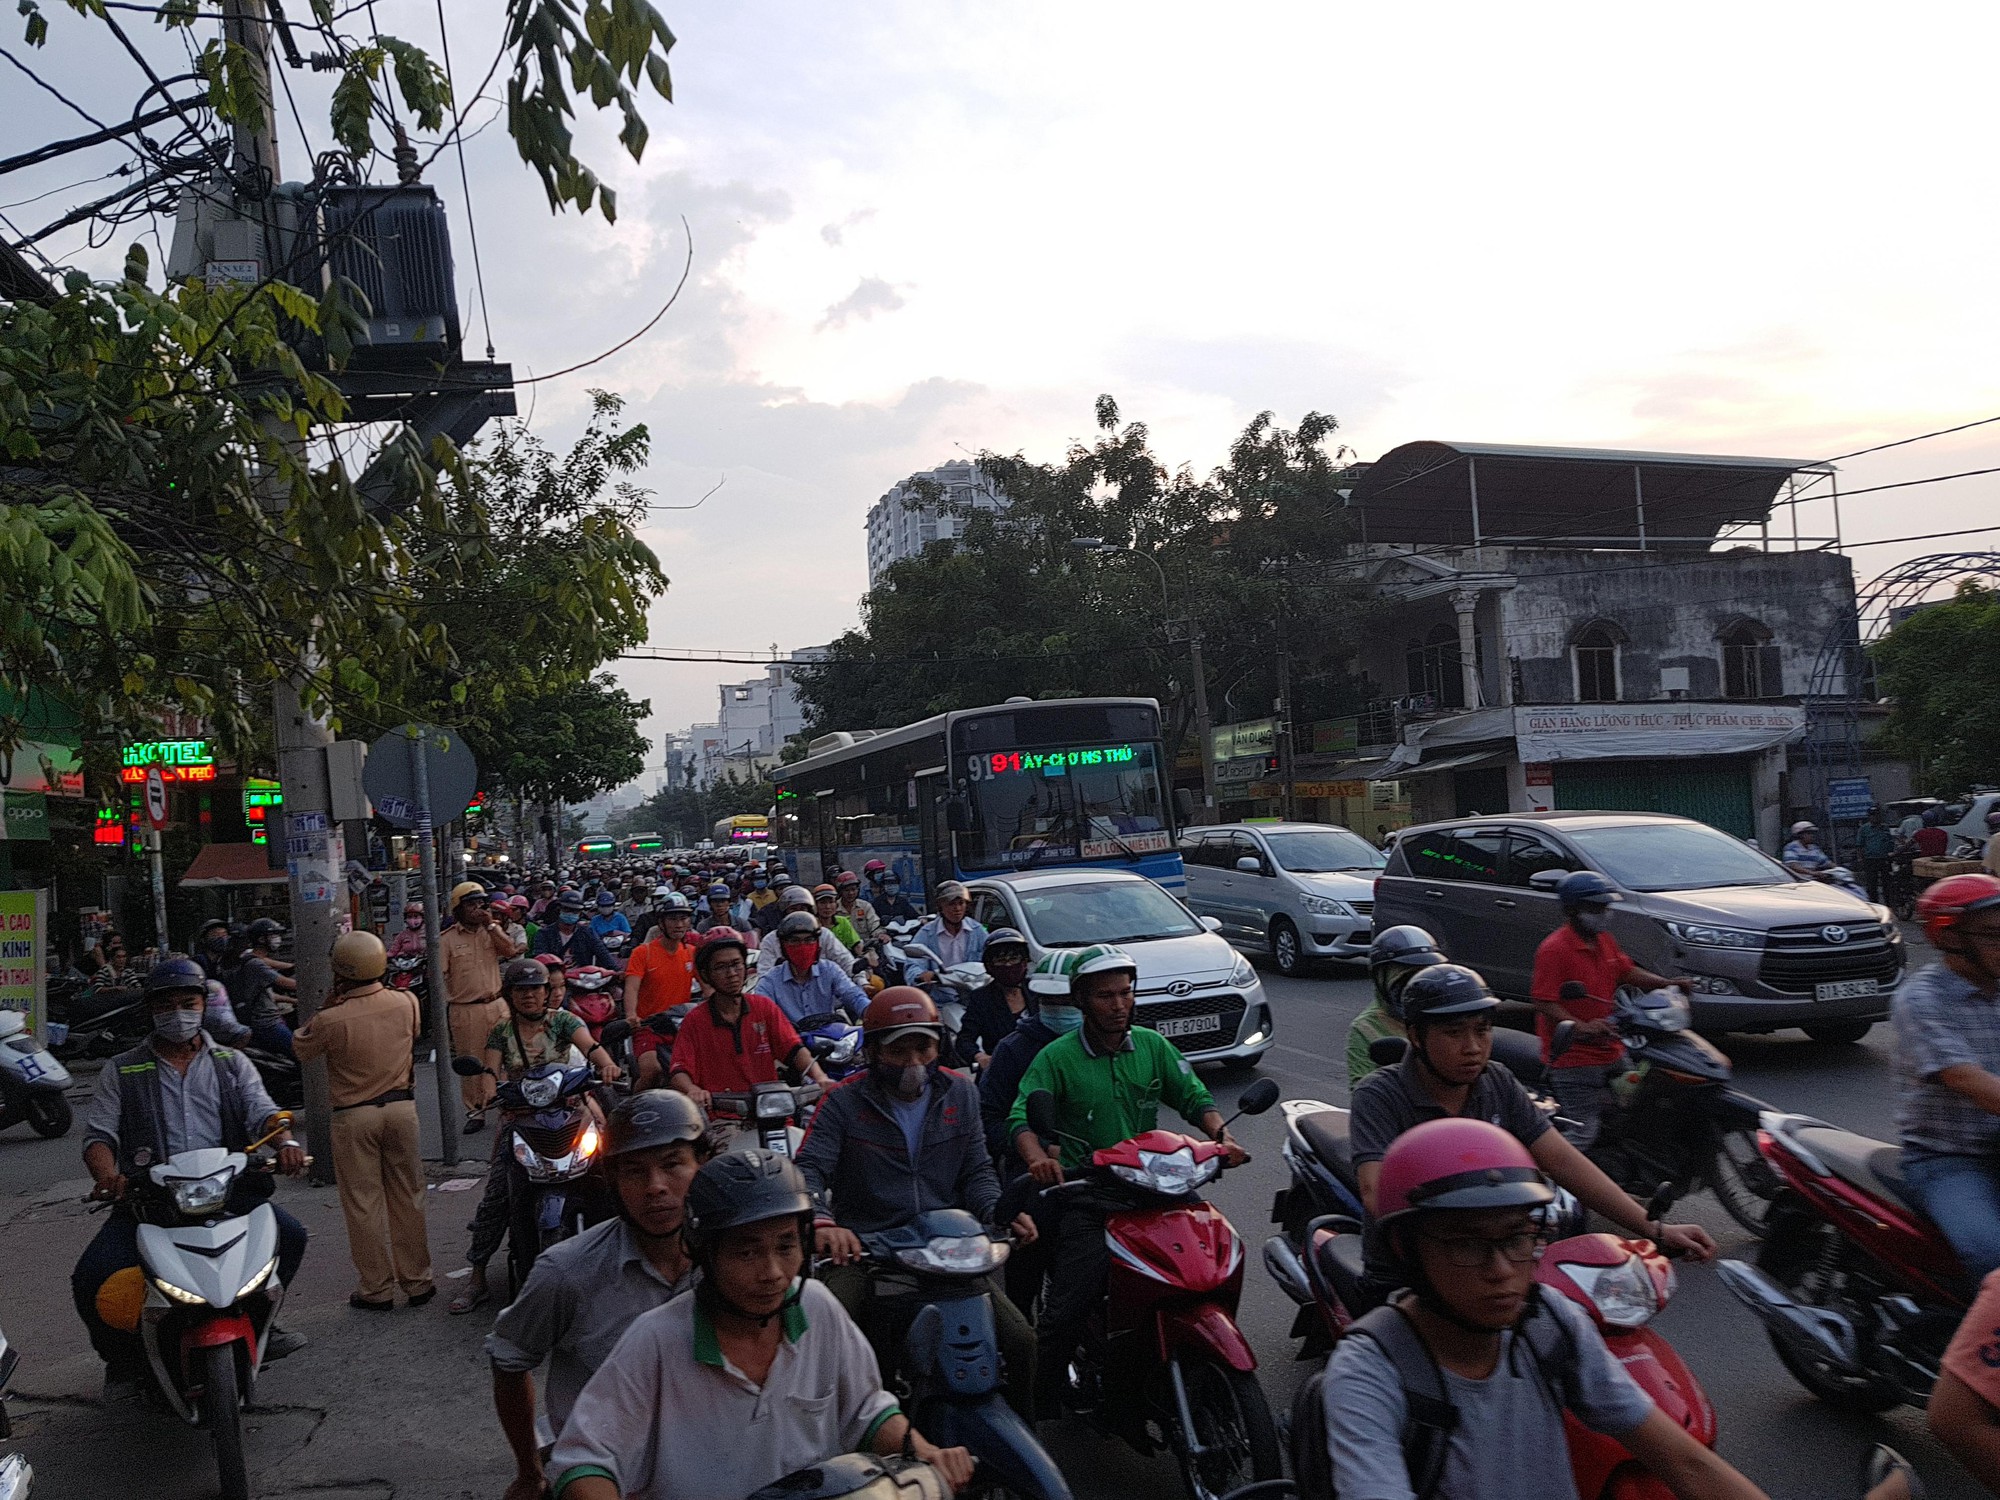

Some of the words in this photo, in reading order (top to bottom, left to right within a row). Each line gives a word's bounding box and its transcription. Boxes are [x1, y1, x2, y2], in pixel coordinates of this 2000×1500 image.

[968, 755, 995, 781] 91
[992, 752, 1021, 773] 91
[1081, 750, 1102, 764] NS
[10, 913, 31, 931] CAO
[2, 937, 31, 958] KÍNH
